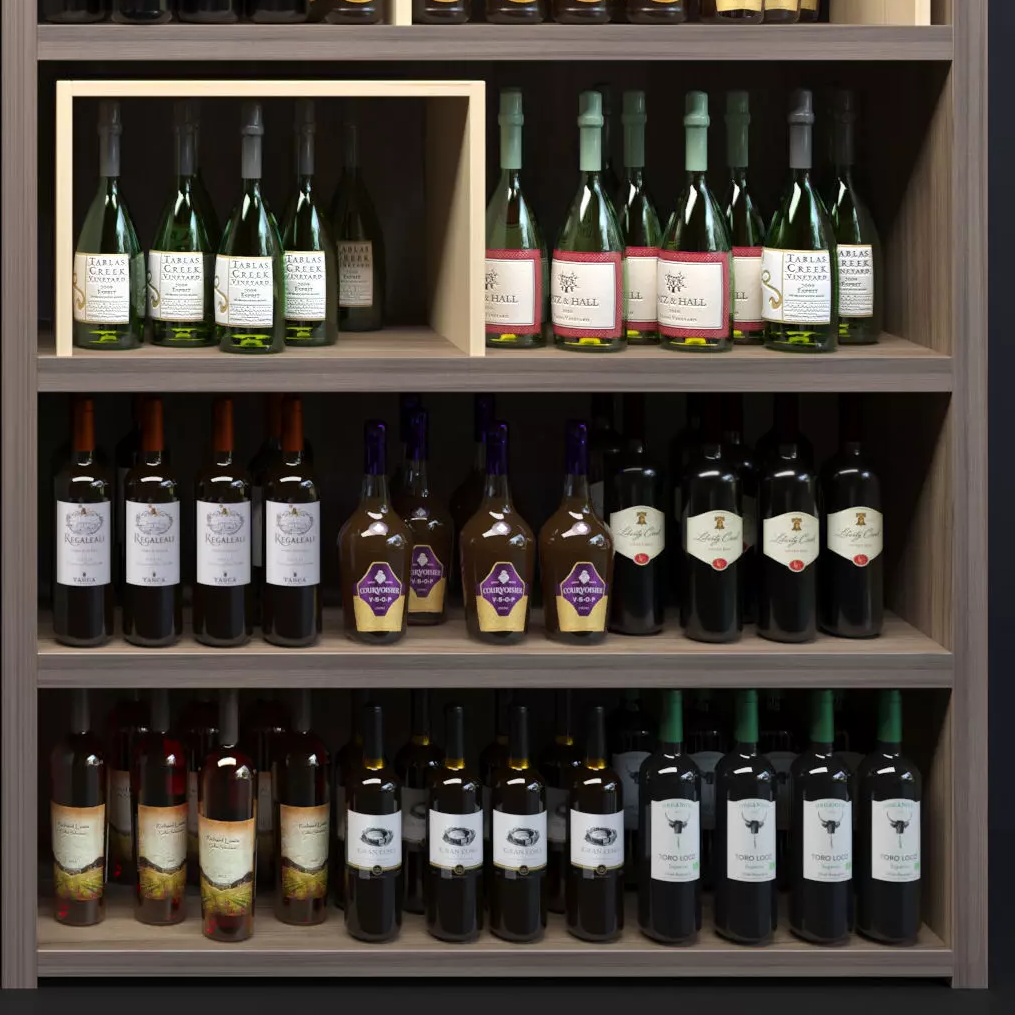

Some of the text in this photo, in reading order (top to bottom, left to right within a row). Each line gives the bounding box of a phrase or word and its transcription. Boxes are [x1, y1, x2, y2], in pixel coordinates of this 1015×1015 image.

[287, 254, 322, 263] TABLAS
[787, 254, 827, 263] TABLAS
[839, 250, 870, 258] ABLAS
[88, 257, 126, 266] TABLAS
[163, 255, 201, 264] TABLAS
[841, 259, 870, 267] REEK
[163, 264, 201, 273] CREEK
[232, 260, 269, 269] TABLAS
[287, 263, 322, 273] CREEK
[787, 264, 827, 273] CREEK
[88, 266, 126, 276] CREEK
[232, 269, 269, 278] CREEK
[87, 275, 126, 283] VINEYARD
[162, 273, 201, 281] VINEYARD
[786, 273, 827, 281] VINEYARD
[231, 278, 269, 286] VINEYARD
[491, 295, 518, 303] HALL
[571, 298, 599, 307] HALL
[678, 297, 707, 307] HALL
[359, 586, 400, 595] COURVOISIER
[482, 586, 523, 595] COURVOISIER
[562, 586, 603, 595] COURVOISIER
